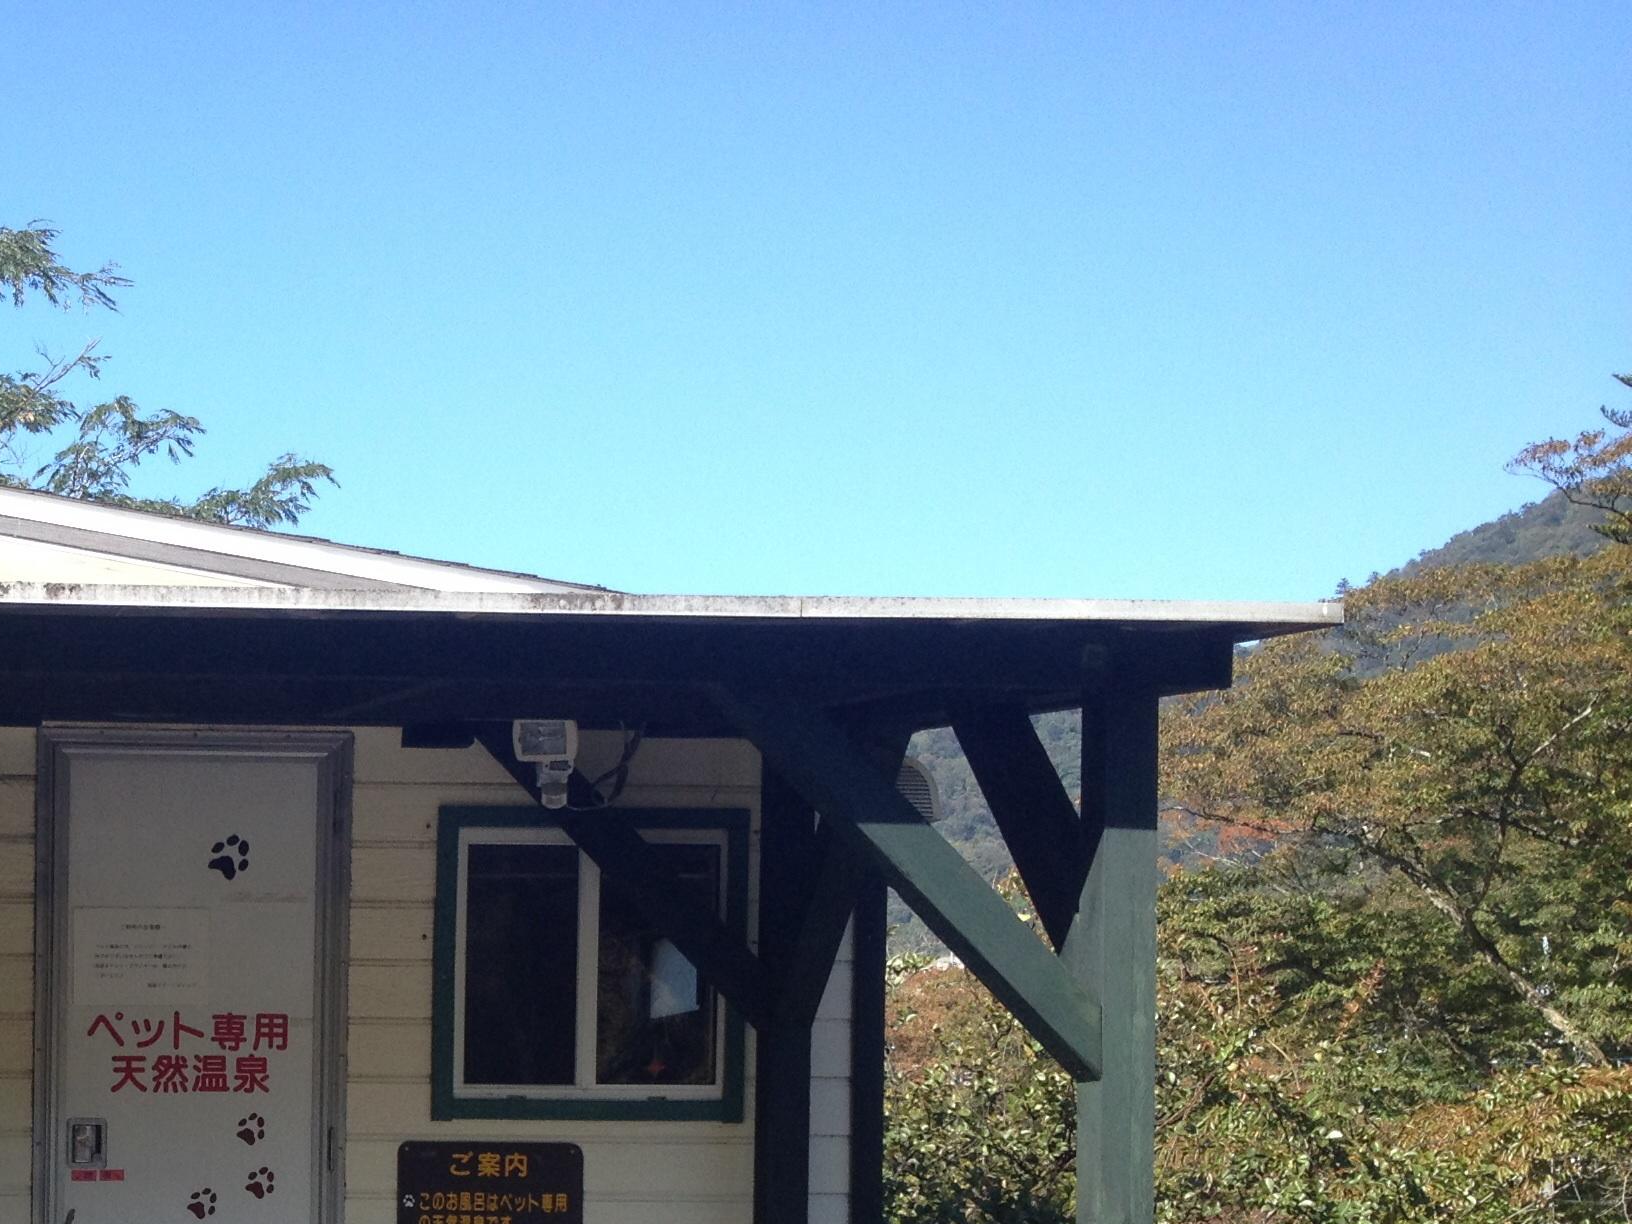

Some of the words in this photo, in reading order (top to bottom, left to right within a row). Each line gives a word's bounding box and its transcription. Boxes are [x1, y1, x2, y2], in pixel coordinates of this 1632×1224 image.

[87, 1010, 289, 1051] ペット専用
[110, 1053, 270, 1094] 天然温泉
[449, 1151, 528, 1178] ご案内
